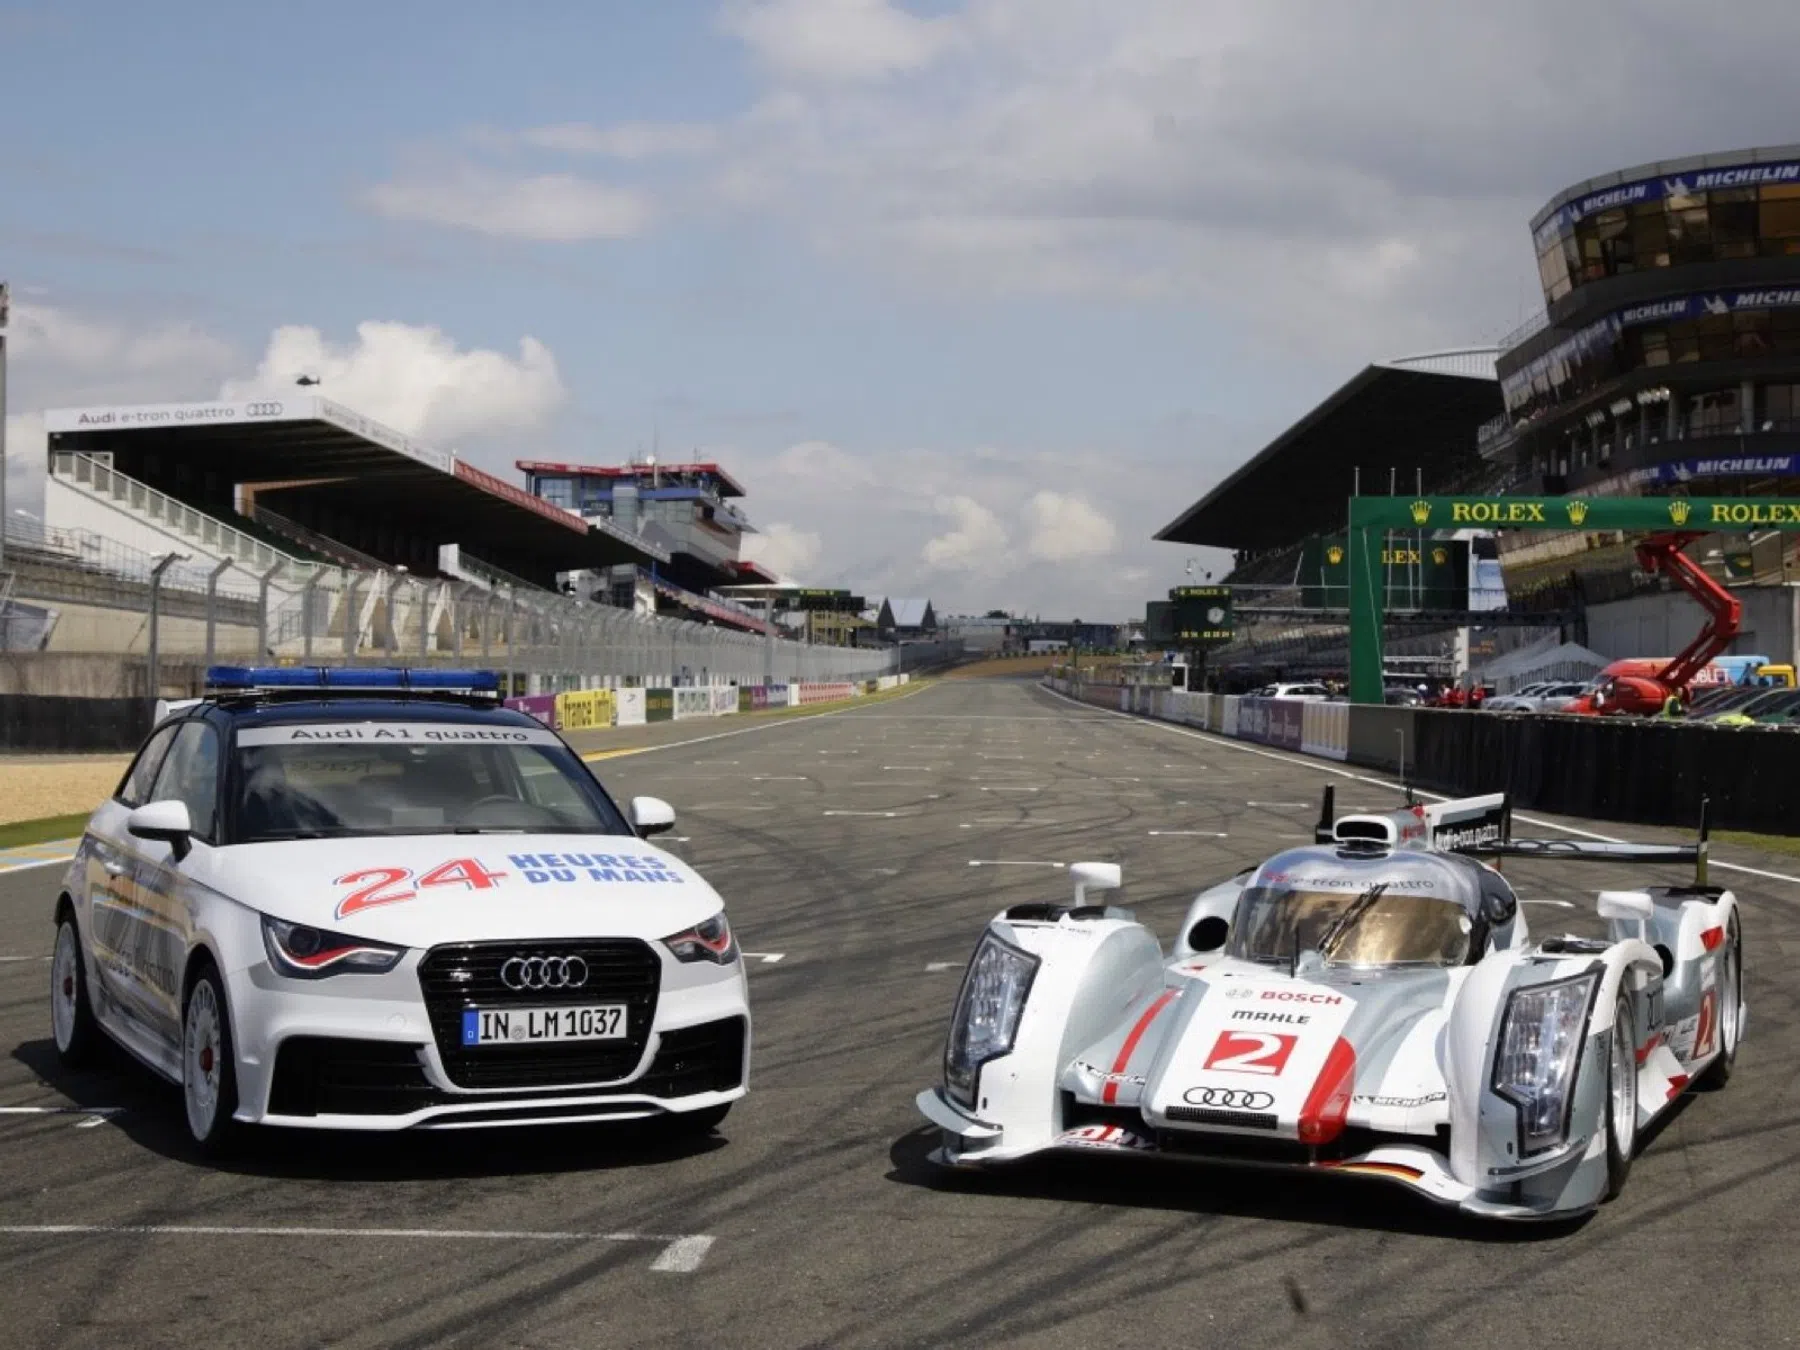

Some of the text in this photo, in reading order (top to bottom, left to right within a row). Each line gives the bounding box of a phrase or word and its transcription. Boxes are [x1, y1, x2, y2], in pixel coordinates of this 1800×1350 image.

[1696, 165, 1799, 188] MICHELIN
[1583, 185, 1647, 211] MICHELIN
[1623, 300, 1686, 321] MICHELIN
[79, 407, 235, 425] Audi e-tron quattro
[1697, 456, 1790, 473] MICHELIN
[1453, 503, 1545, 521] ROLEX
[1711, 504, 1800, 522] ROLEX
[291, 728, 528, 742] Audi A1 quattro
[509, 853, 668, 870] HEURES
[525, 868, 685, 884] DU MANS
[333, 856, 508, 920] 24
[1261, 991, 1342, 1005] BOSCH
[481, 1008, 622, 1040] IN LM 1037
[1232, 1010, 1310, 1025] MAHLE
[1695, 993, 1714, 1058] 2
[1210, 1031, 1283, 1075] 2
